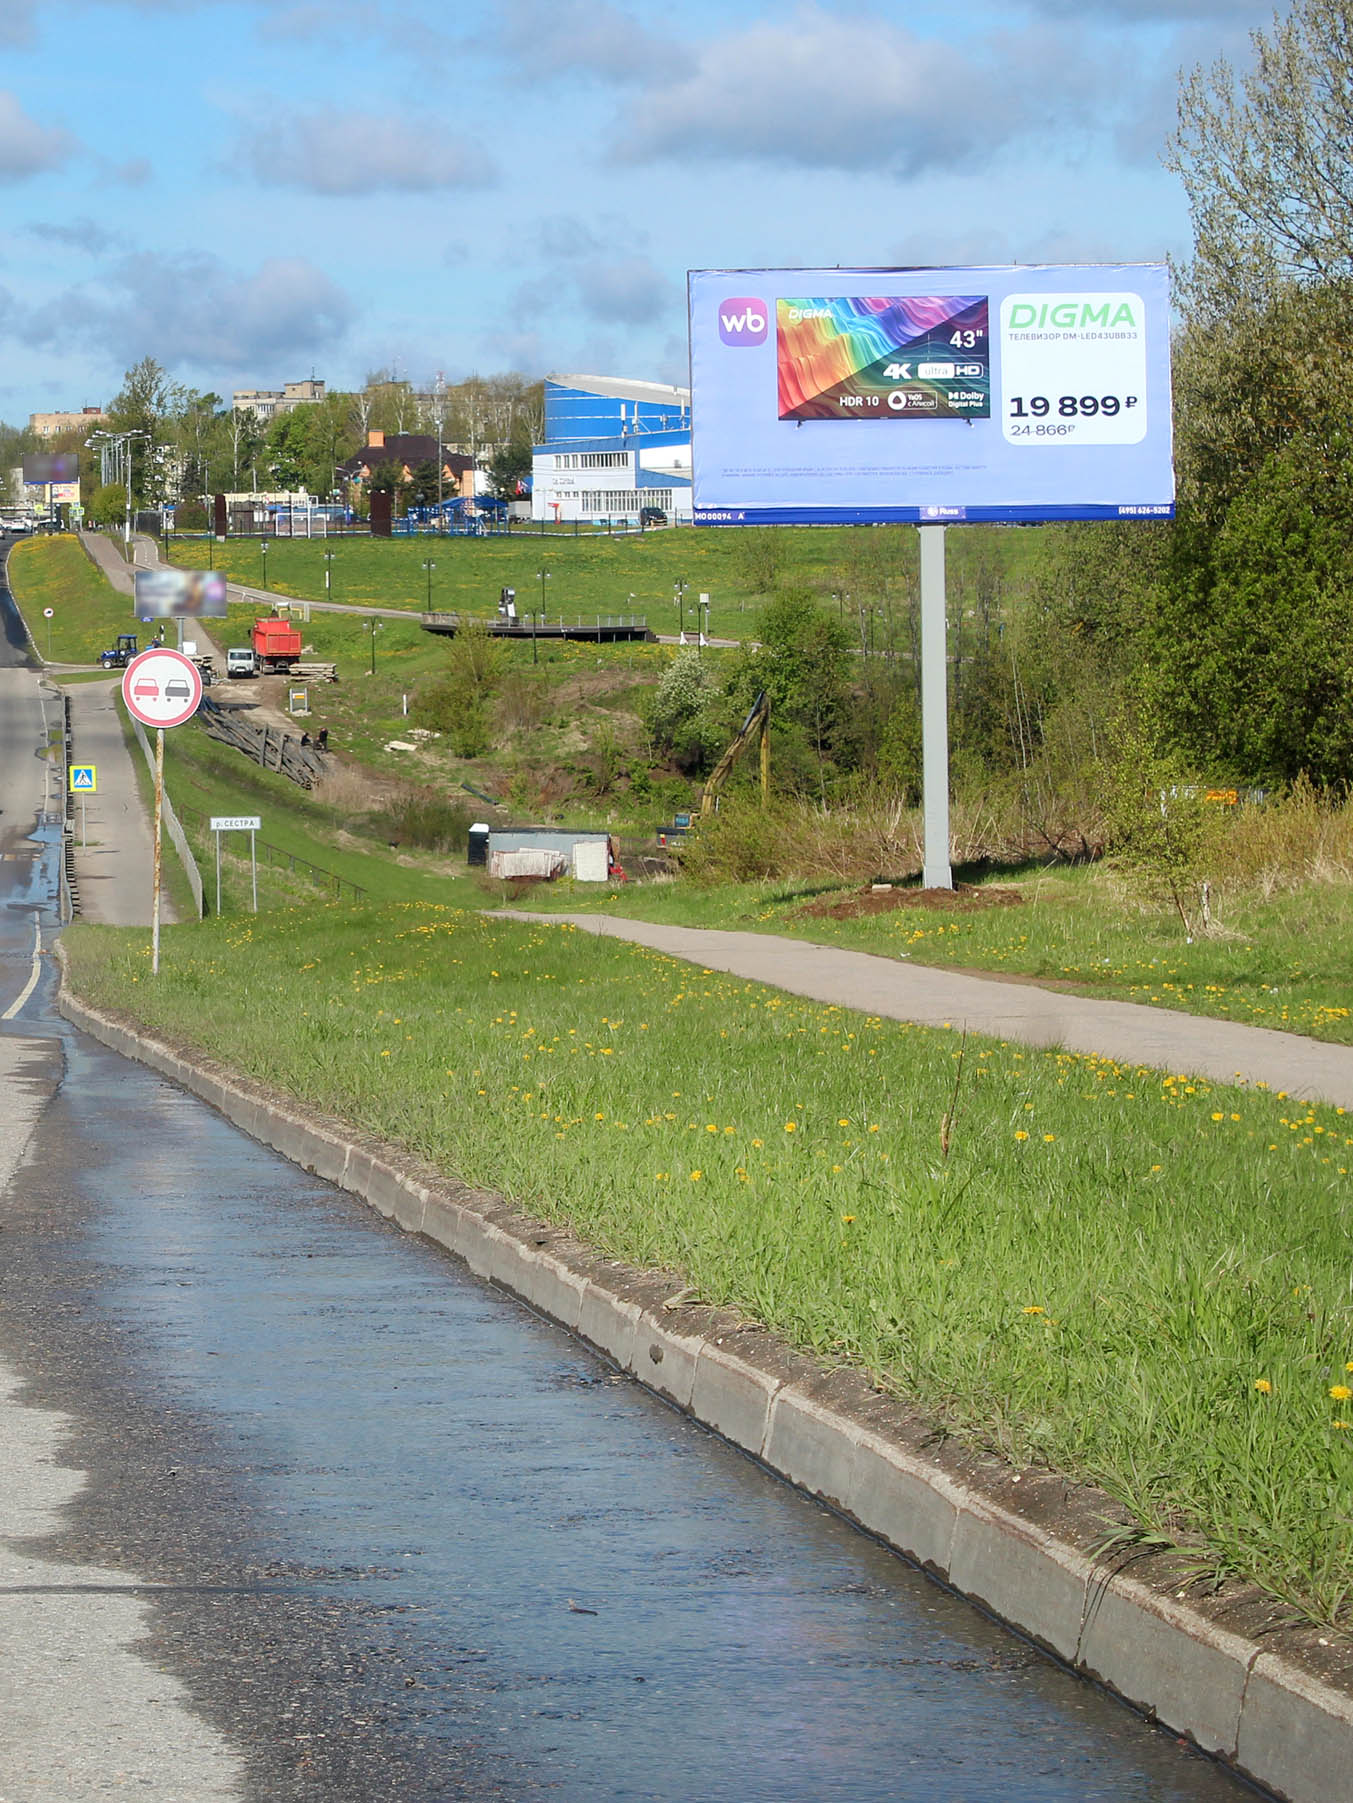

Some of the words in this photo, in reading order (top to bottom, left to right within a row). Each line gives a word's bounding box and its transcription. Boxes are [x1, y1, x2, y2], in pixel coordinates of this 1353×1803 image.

[721, 307, 765, 333] wb
[788, 308, 833, 319] DIGMA
[1008, 303, 1136, 329] DIGMA
[1009, 332, 1061, 341] ТЕЛЕВИЗОР
[883, 363, 912, 379] 4K
[956, 365, 980, 376] HD
[839, 396, 863, 407] HDR
[865, 396, 879, 406] 10
[960, 391, 984, 401] Dolby
[1010, 396, 1050, 418] 19
